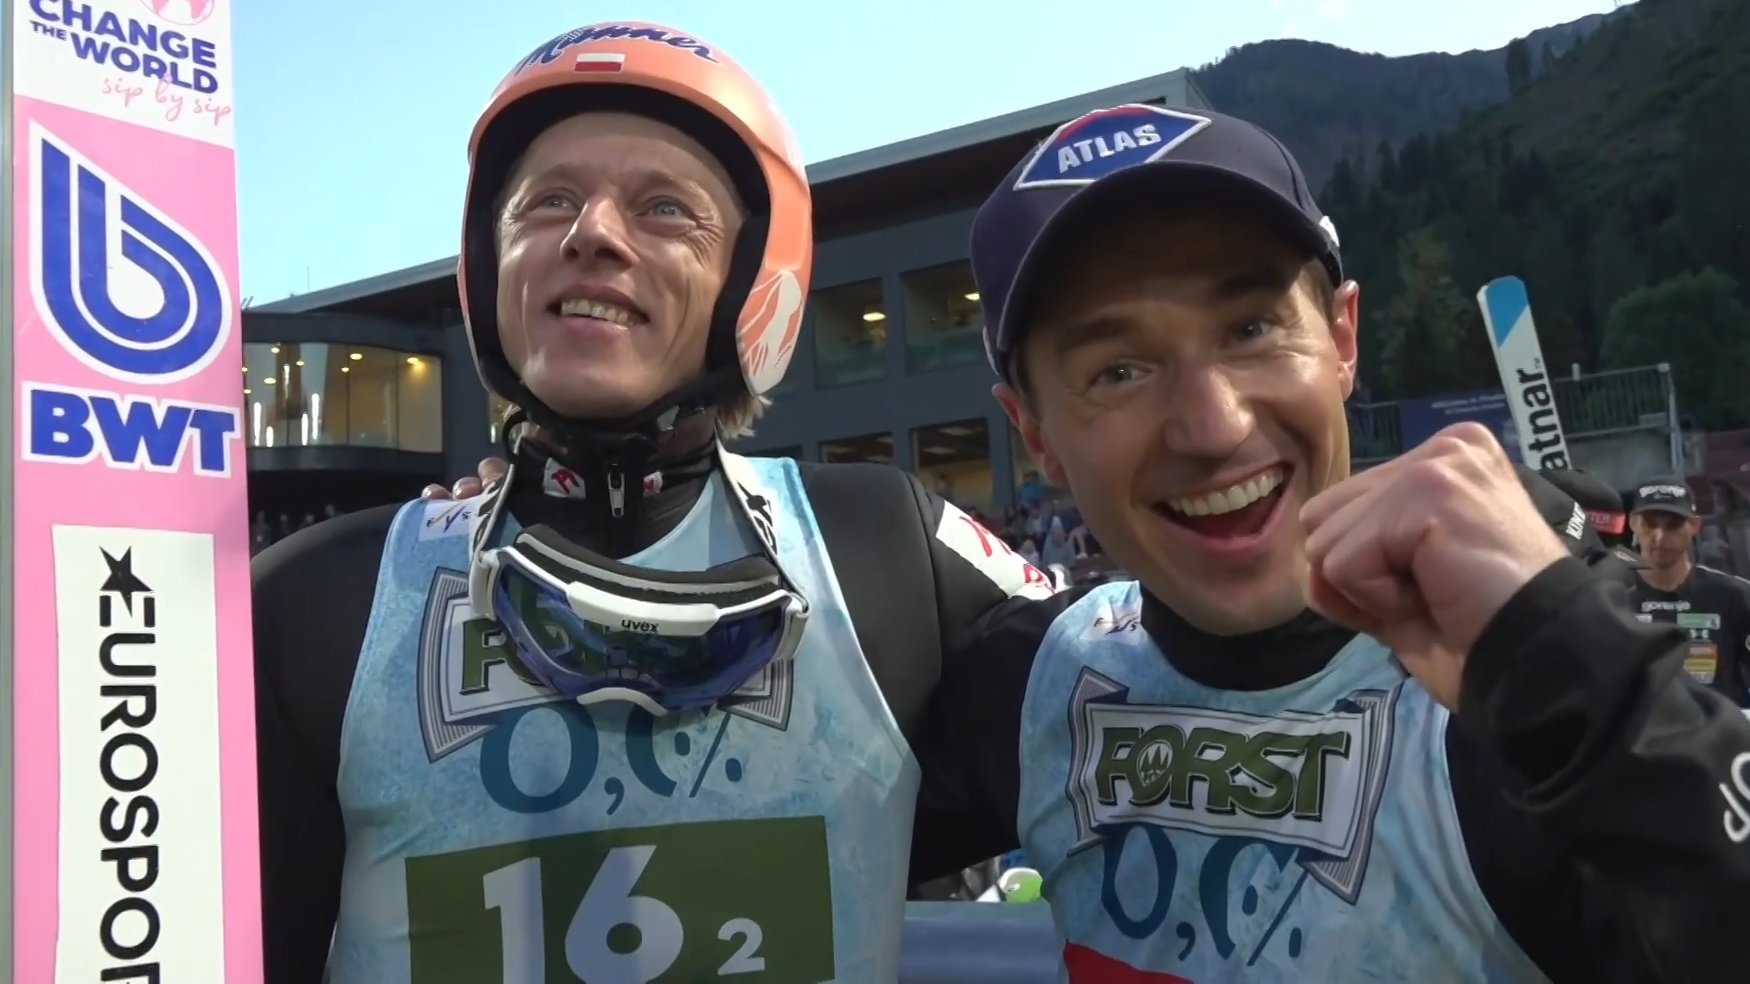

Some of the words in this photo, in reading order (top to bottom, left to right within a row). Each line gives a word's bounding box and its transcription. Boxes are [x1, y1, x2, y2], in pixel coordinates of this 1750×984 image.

[29, 0, 216, 69] CHANGE
[29, 20, 67, 41] THE
[70, 32, 218, 94] WORLD
[102, 78, 144, 107] sip
[154, 74, 184, 121] by
[193, 98, 232, 126] sip
[1057, 124, 1162, 174] ATLAS
[30, 388, 236, 472] BWT
[621, 619, 659, 632] uvex
[1095, 725, 1352, 822] FORST
[482, 843, 684, 984] 16
[716, 917, 766, 976] 2
